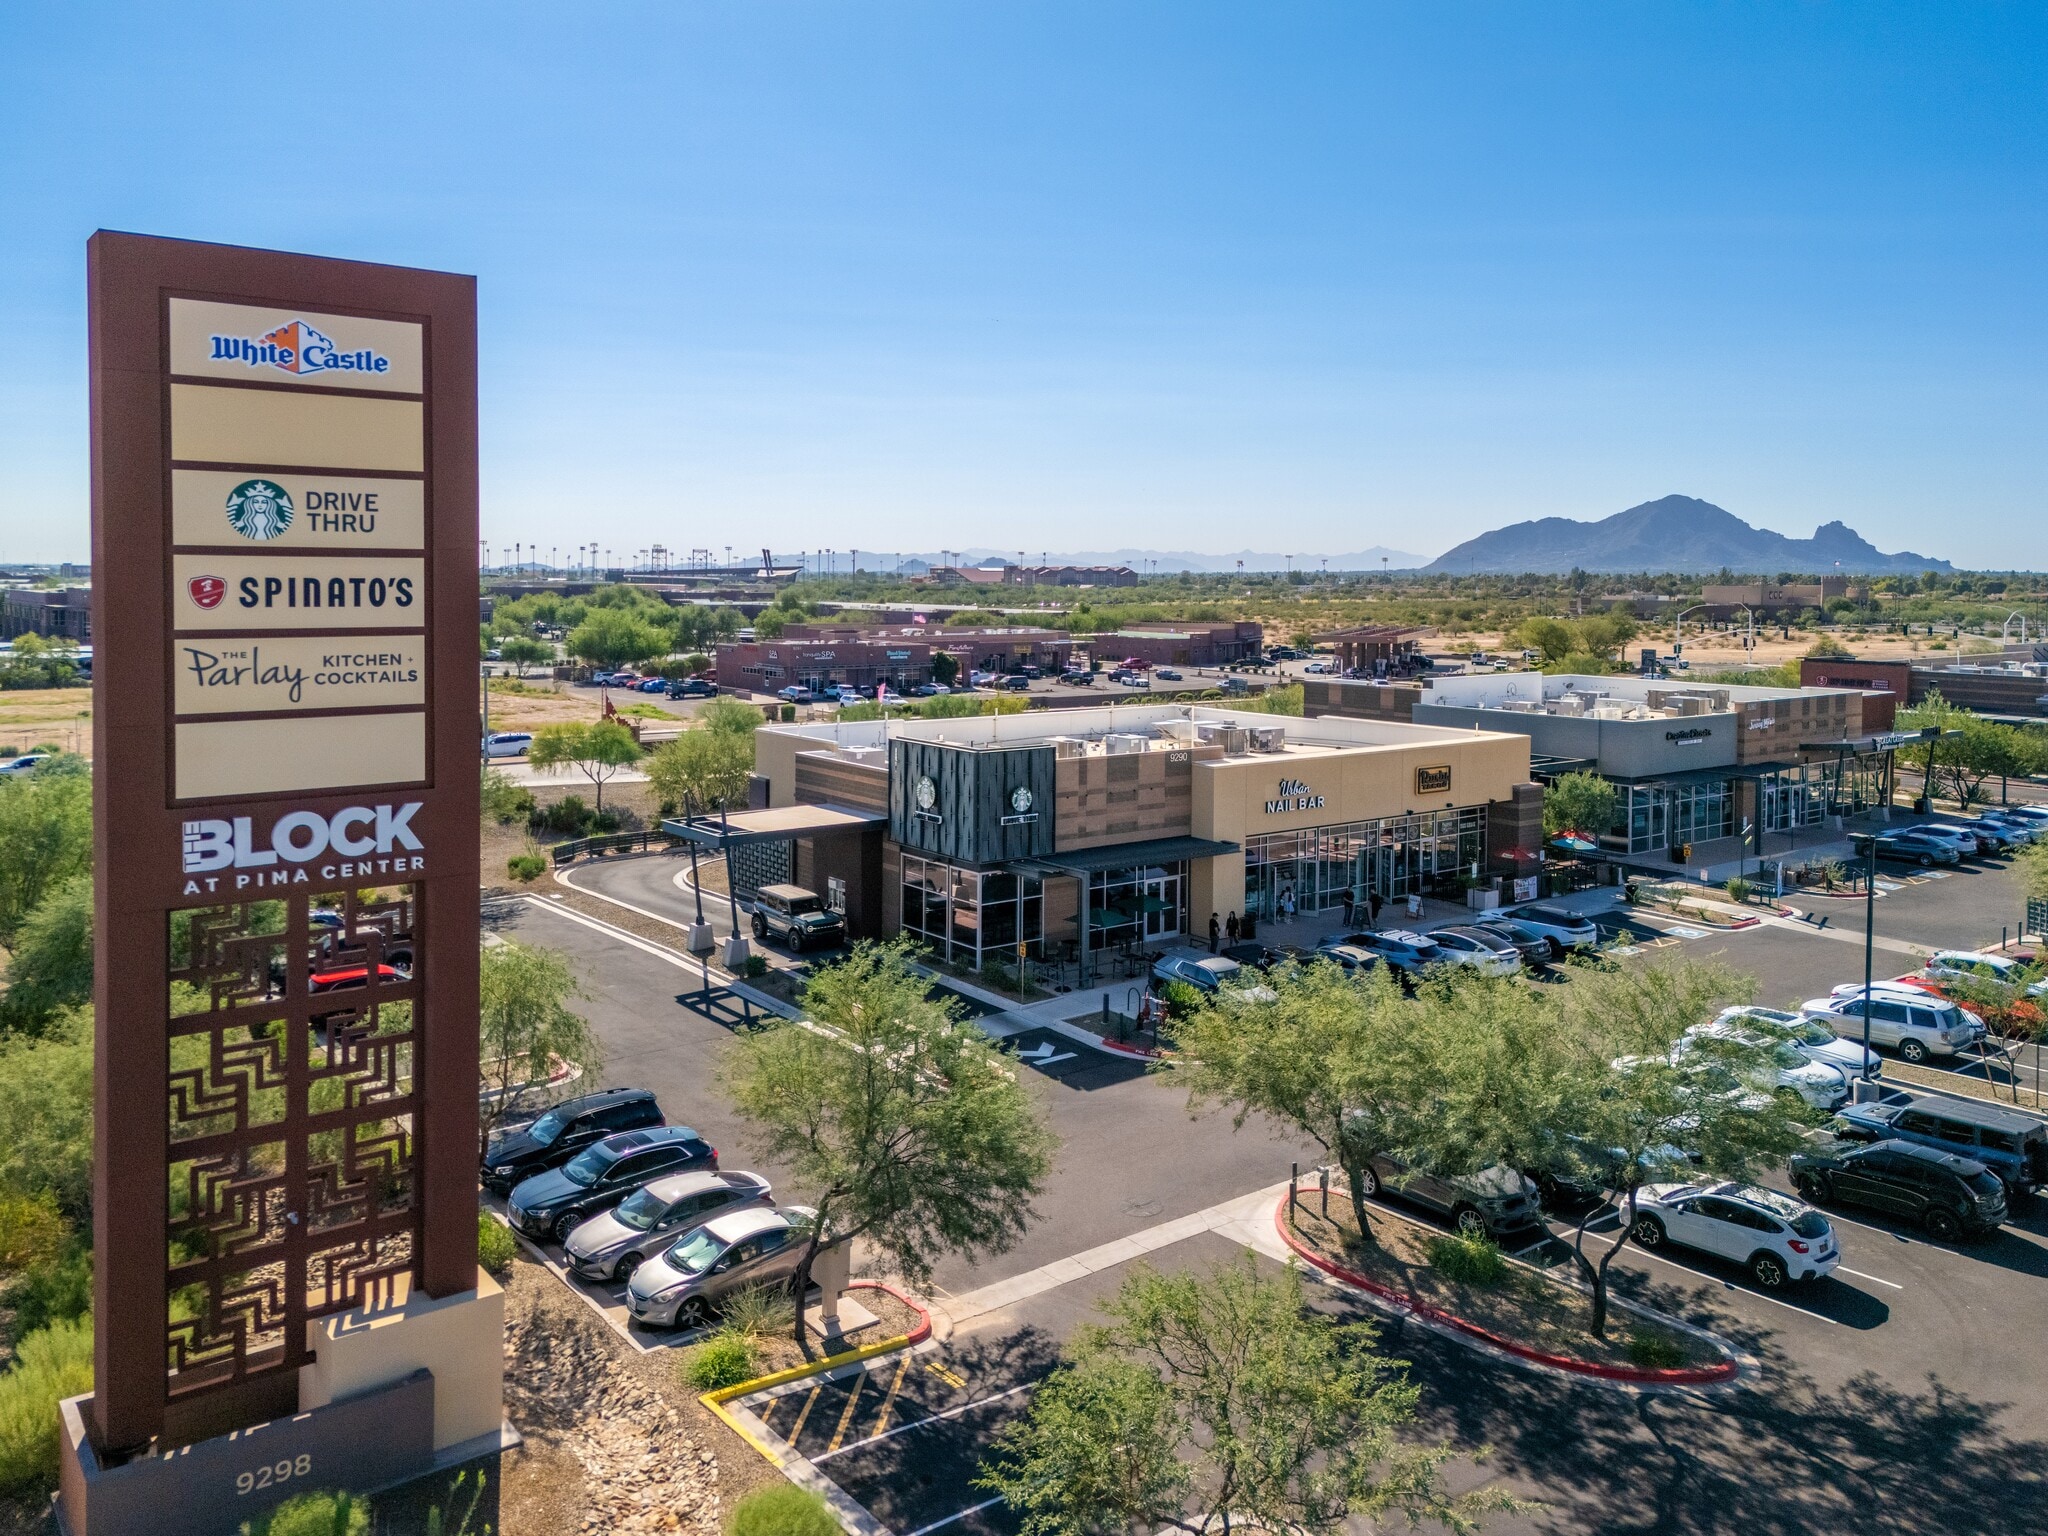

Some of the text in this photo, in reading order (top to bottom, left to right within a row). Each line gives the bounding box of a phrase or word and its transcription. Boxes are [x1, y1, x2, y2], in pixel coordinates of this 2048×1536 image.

[211, 336, 388, 372] White Castle
[306, 491, 379, 513] DRIVE
[307, 513, 375, 533] THRU
[239, 576, 414, 608] SPINATO'S
[222, 651, 247, 659] THE
[323, 653, 402, 668] KITCHEN
[183, 647, 310, 703] Parlay
[314, 669, 418, 685] COCKTAILS
[1170, 752, 1188, 762] 9290
[1280, 778, 1311, 797] Urban
[1266, 796, 1325, 813] NAIL BAR
[183, 802, 425, 873] THE BLOCK
[183, 857, 425, 895] AT PIMA CENTER
[1382, 1291, 1413, 1309] FIRE LANE
[1423, 1308, 1459, 1328] NO PARKING
[236, 1454, 311, 1495] 9298
